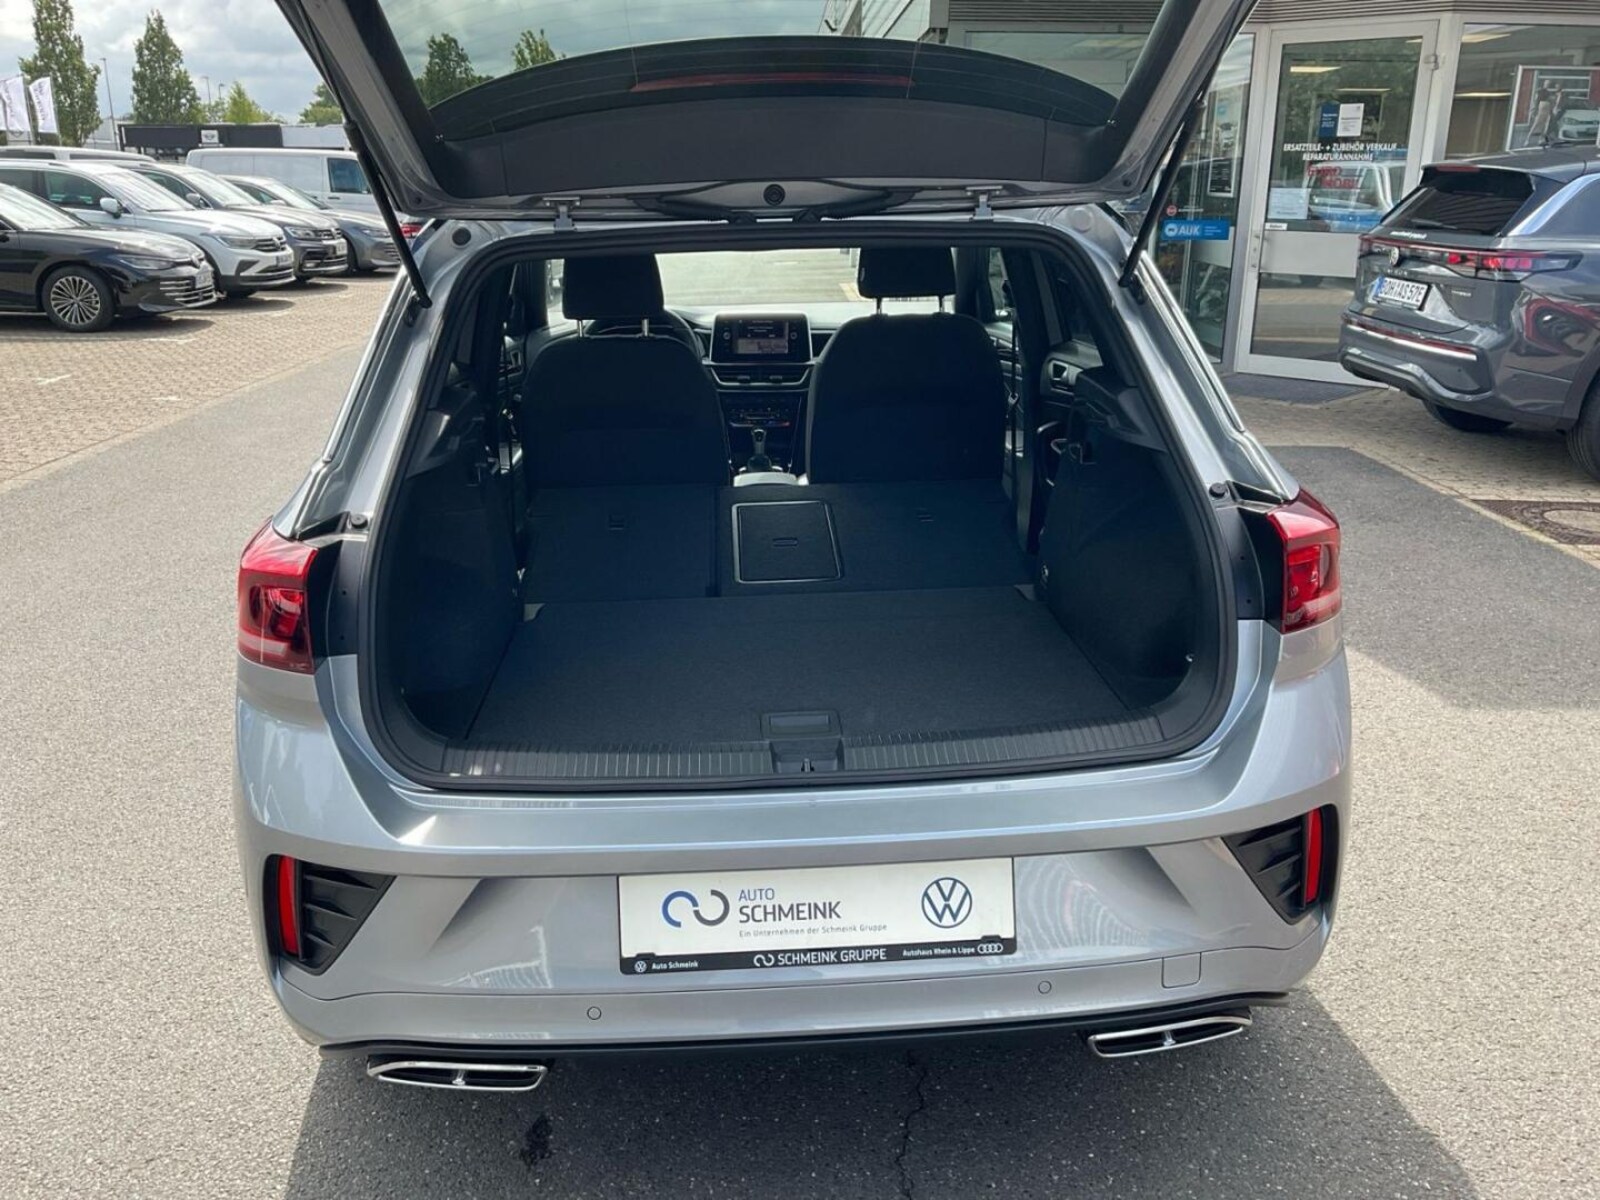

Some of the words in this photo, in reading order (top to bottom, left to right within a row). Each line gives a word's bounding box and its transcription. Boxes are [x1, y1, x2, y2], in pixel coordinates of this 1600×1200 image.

[1332, 141, 1365, 151] ZUBEHÖR
[1366, 143, 1397, 151] VERKAUF
[738, 888, 775, 902] AUTO
[739, 901, 841, 923] SCHMEINK
[739, 930, 752, 938] Ein
[753, 927, 805, 937] Unternehmen
[807, 927, 820, 935] der
[821, 925, 857, 934] Schmeink
[859, 924, 887, 933] Gruppe
[777, 951, 838, 966] SCHMEINK
[840, 948, 887, 962] GRUPPE
[902, 949, 933, 957] Autohaus
[957, 946, 976, 954] Lippe
[652, 962, 667, 970] Auto
[668, 960, 699, 969] Schmeink
